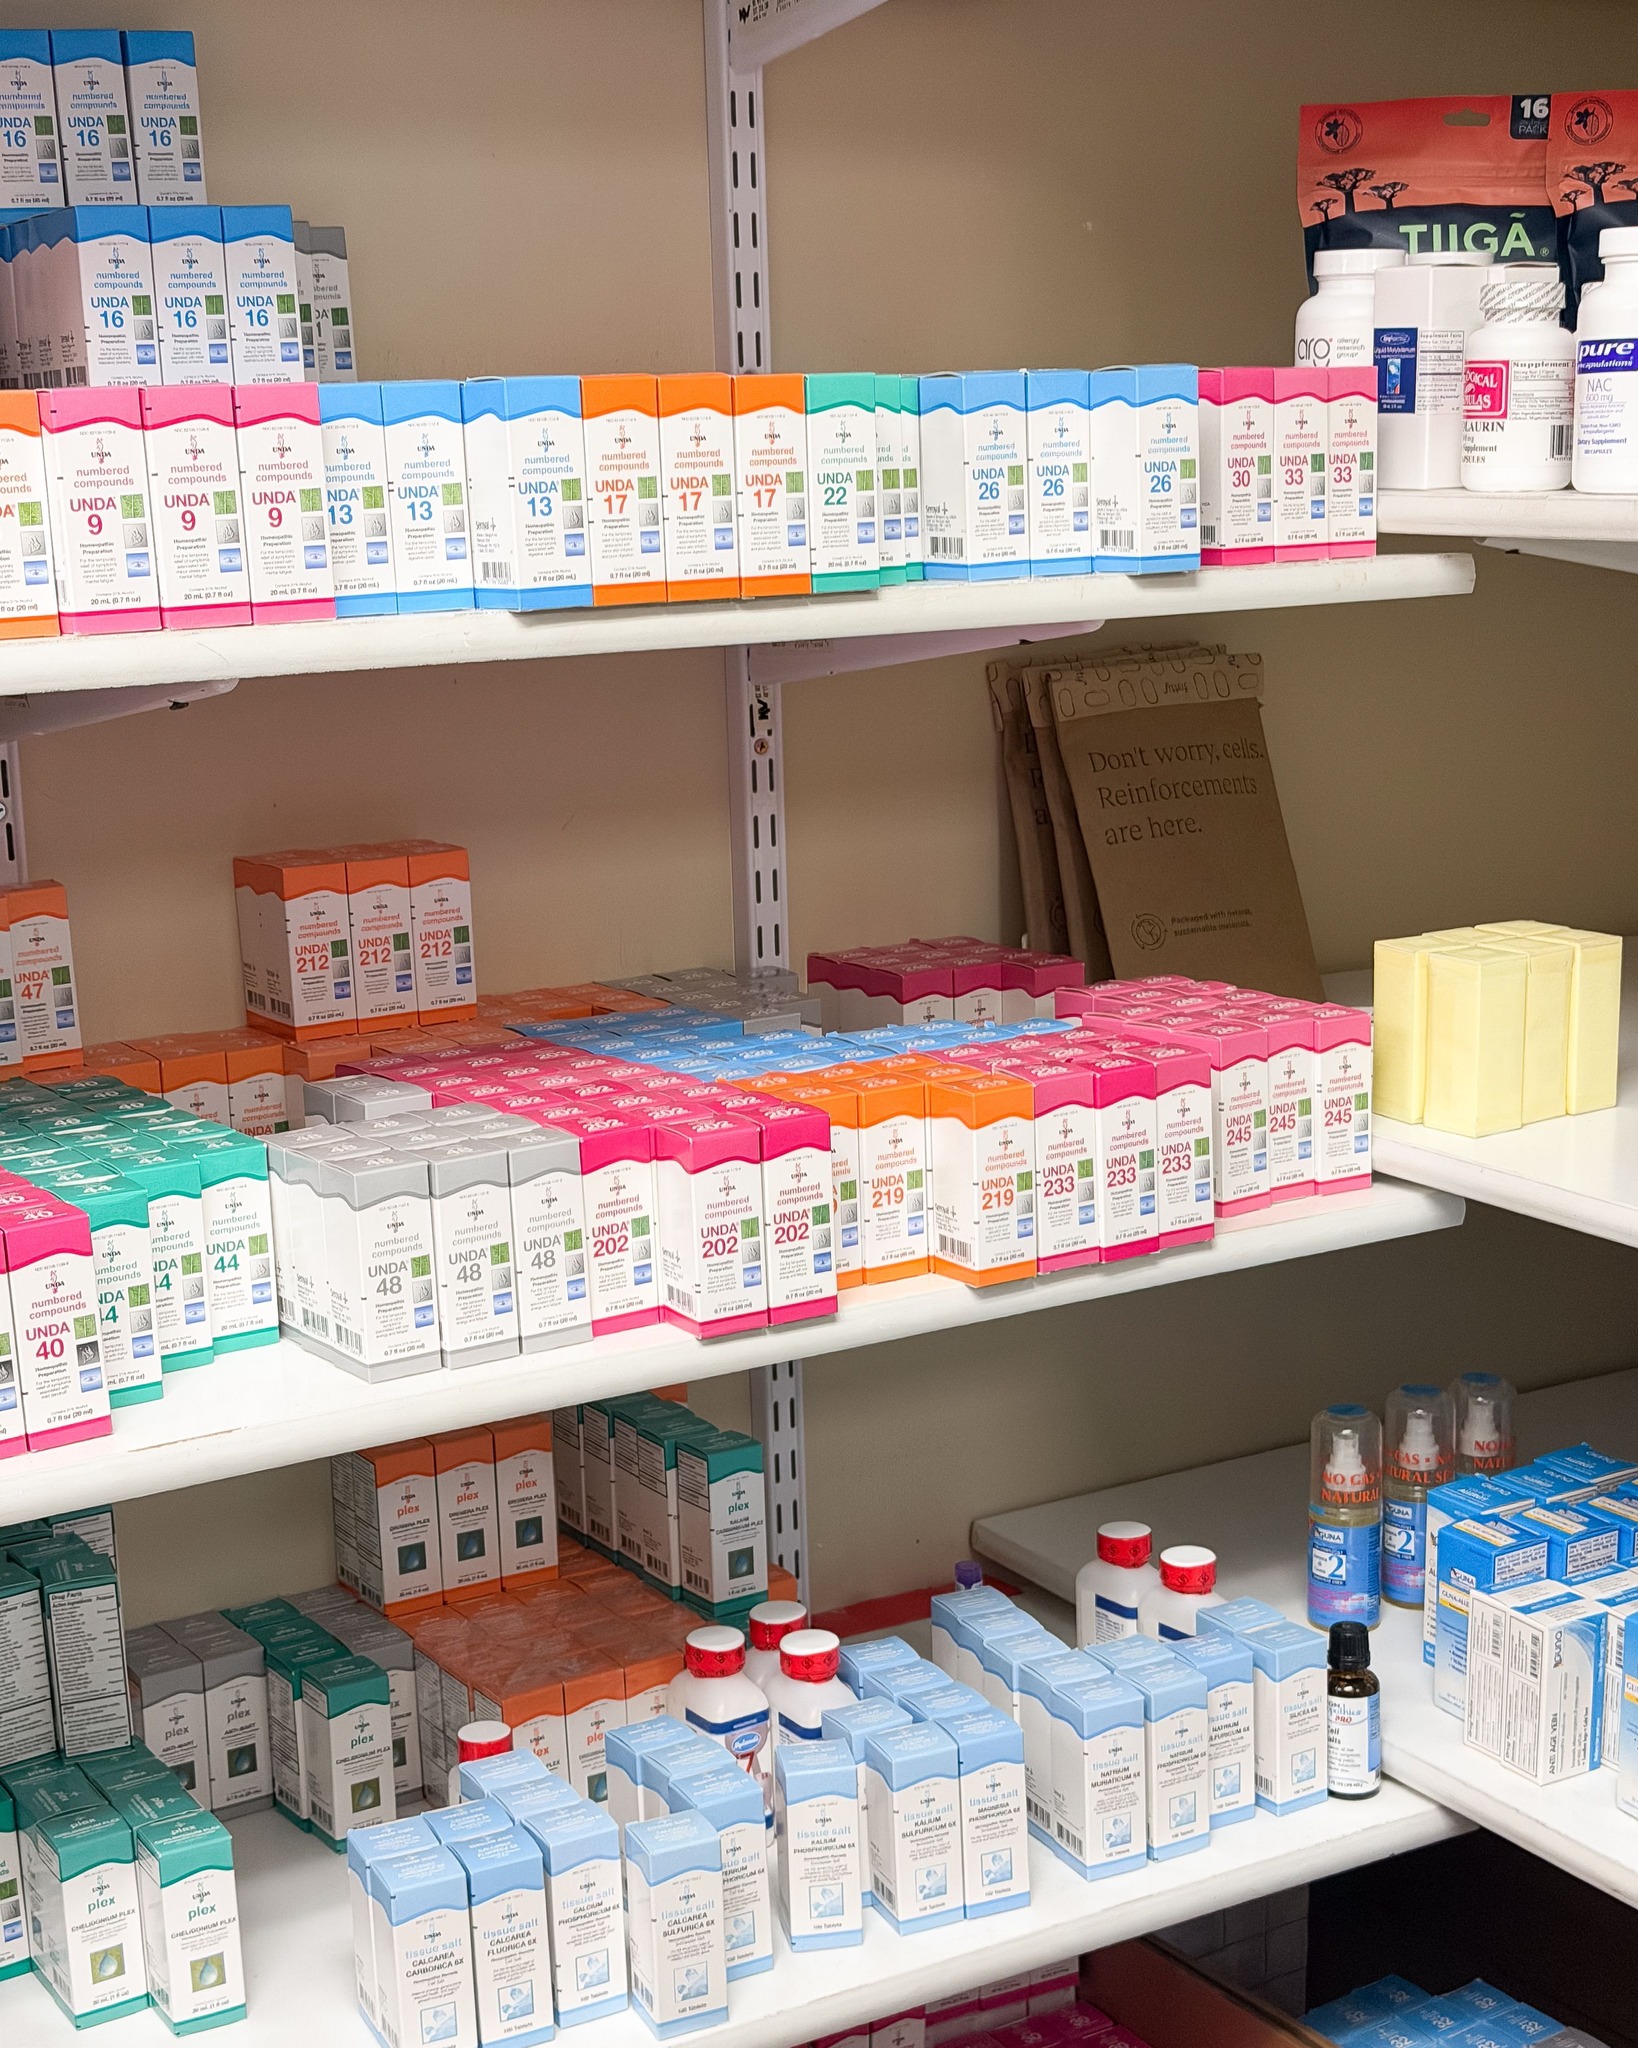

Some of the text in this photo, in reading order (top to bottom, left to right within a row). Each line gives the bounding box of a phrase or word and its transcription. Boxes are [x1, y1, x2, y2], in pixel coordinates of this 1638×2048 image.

[1520, 99, 1548, 119] 16
[68, 116, 104, 128] UNDA
[141, 116, 177, 128] UNDA
[1518, 124, 1548, 134] PACK
[3, 130, 26, 148] 16
[76, 130, 100, 148] 16
[149, 130, 172, 148] 16
[1400, 212, 1536, 257] TIIGÃ
[96, 271, 140, 280] numbered
[94, 280, 143, 290] compounds
[90, 296, 130, 308] UNDA
[164, 296, 202, 308] UNDA
[237, 296, 274, 308] UNDA
[100, 310, 124, 328] 16
[173, 310, 198, 328] 16
[245, 310, 269, 327] 16
[1579, 342, 1635, 362] pure
[1587, 378, 1612, 392] NAC
[1586, 394, 1614, 403] 600 mg
[524, 454, 570, 464] numbered
[1144, 460, 1177, 474] UNDA
[1227, 456, 1256, 469] UNDA
[1280, 454, 1308, 468] UNDA
[1328, 453, 1357, 466] UNDA
[170, 462, 222, 473] numbered
[522, 464, 574, 476] compounds
[972, 468, 1005, 480] UNDA
[1036, 464, 1070, 478] UNDA
[1333, 466, 1352, 484] 33
[168, 474, 227, 484] compounds
[595, 478, 634, 492] UNDA
[670, 476, 708, 490] UNDA
[745, 473, 782, 487] UNDA
[816, 472, 854, 485] UNDA
[1150, 475, 1172, 494] 26
[1232, 470, 1251, 488] 30
[1284, 468, 1304, 486] 33
[398, 486, 438, 499] UNDA
[518, 480, 558, 494] UNDA
[978, 482, 1000, 500] 26
[1042, 479, 1064, 497] 26
[164, 494, 210, 508] UNDA
[252, 491, 296, 505] UNDA
[328, 489, 360, 502] NDA
[678, 491, 702, 512] 17
[754, 488, 776, 508] 17
[824, 486, 847, 506] 22
[70, 497, 117, 512] UNDA
[407, 501, 432, 520] 13
[527, 496, 552, 517] 13
[604, 494, 628, 514] 17
[181, 510, 196, 531] 9
[268, 507, 283, 528] 9
[328, 504, 353, 525] 13
[88, 514, 104, 536] 9
[1088, 738, 1264, 774] Don't worry, cells.
[1098, 774, 1258, 810] Reinforcements
[1105, 816, 1202, 846] are here.
[300, 920, 338, 930] numbered
[298, 928, 341, 939] compounds
[420, 930, 452, 942] UNDA
[295, 943, 330, 956] UNDA
[358, 936, 391, 949] UNDA
[420, 940, 452, 958] 212
[296, 955, 329, 974] 212
[360, 948, 391, 966] 212
[14, 970, 50, 984] UNDA
[21, 984, 43, 1000] 47
[1269, 1102, 1295, 1116] UNDA
[1324, 1096, 1352, 1110] UNDA
[1226, 1114, 1252, 1128] UNDA
[1270, 1114, 1296, 1133] 245
[1324, 1108, 1352, 1126] 245
[1226, 1128, 1251, 1146] 245
[1161, 1141, 1191, 1156] UNDA
[1043, 1163, 1074, 1178] UNDA
[1106, 1155, 1136, 1170] UNDA
[1162, 1154, 1192, 1174] 233
[871, 1174, 904, 1189] UNDA
[982, 1176, 1014, 1191] UNDA
[1107, 1167, 1136, 1188] 233
[779, 1183, 821, 1197] numbered
[1043, 1176, 1075, 1198] 233
[777, 1192, 824, 1206] compounds
[872, 1187, 904, 1208] 219
[982, 1189, 1014, 1211] 219
[773, 1209, 809, 1225] UNDA
[592, 1222, 628, 1238] UNDA
[701, 1223, 738, 1239] UNDA
[774, 1223, 809, 1245] 202
[206, 1240, 245, 1255] UNDA
[523, 1236, 561, 1252] UNDA
[593, 1236, 629, 1258] 202
[702, 1237, 738, 1258] 202
[214, 1255, 239, 1274] 44
[448, 1249, 487, 1265] UNDA
[531, 1250, 556, 1269] 48
[368, 1262, 407, 1278] UNDA
[456, 1263, 482, 1283] 48
[376, 1276, 402, 1296] 48
[31, 1291, 82, 1309] numbered
[29, 1302, 86, 1320] compounds
[26, 1322, 70, 1341] UNDA
[35, 1338, 64, 1360] 40
[1394, 1450, 1420, 1465] GAS
[515, 1478, 538, 1492] plex
[1322, 1472, 1374, 1486] NO GAS
[456, 1490, 479, 1505] plex
[397, 1504, 420, 1520] plex
[728, 1502, 750, 1515] plex
[1397, 1530, 1413, 1553] 2
[1328, 1555, 1345, 1579] 2
[227, 1708, 251, 1723] plex
[165, 1726, 190, 1741] plex
[351, 1733, 374, 1748] plex
[969, 1789, 1018, 1806] tissue salt
[904, 1804, 953, 1822] tissue salt
[797, 1824, 851, 1839] tissue salt
[87, 1896, 116, 1914] plex
[188, 1904, 216, 1921] plex
[661, 1899, 715, 1920] tissue salt
[484, 1918, 539, 1939] tissue salt
[490, 1931, 532, 1947] CALCAREA
[406, 1938, 462, 1959] tissue salt
[412, 1952, 455, 1968] CALCAREA
[406, 1962, 453, 1978] CARBONICA
